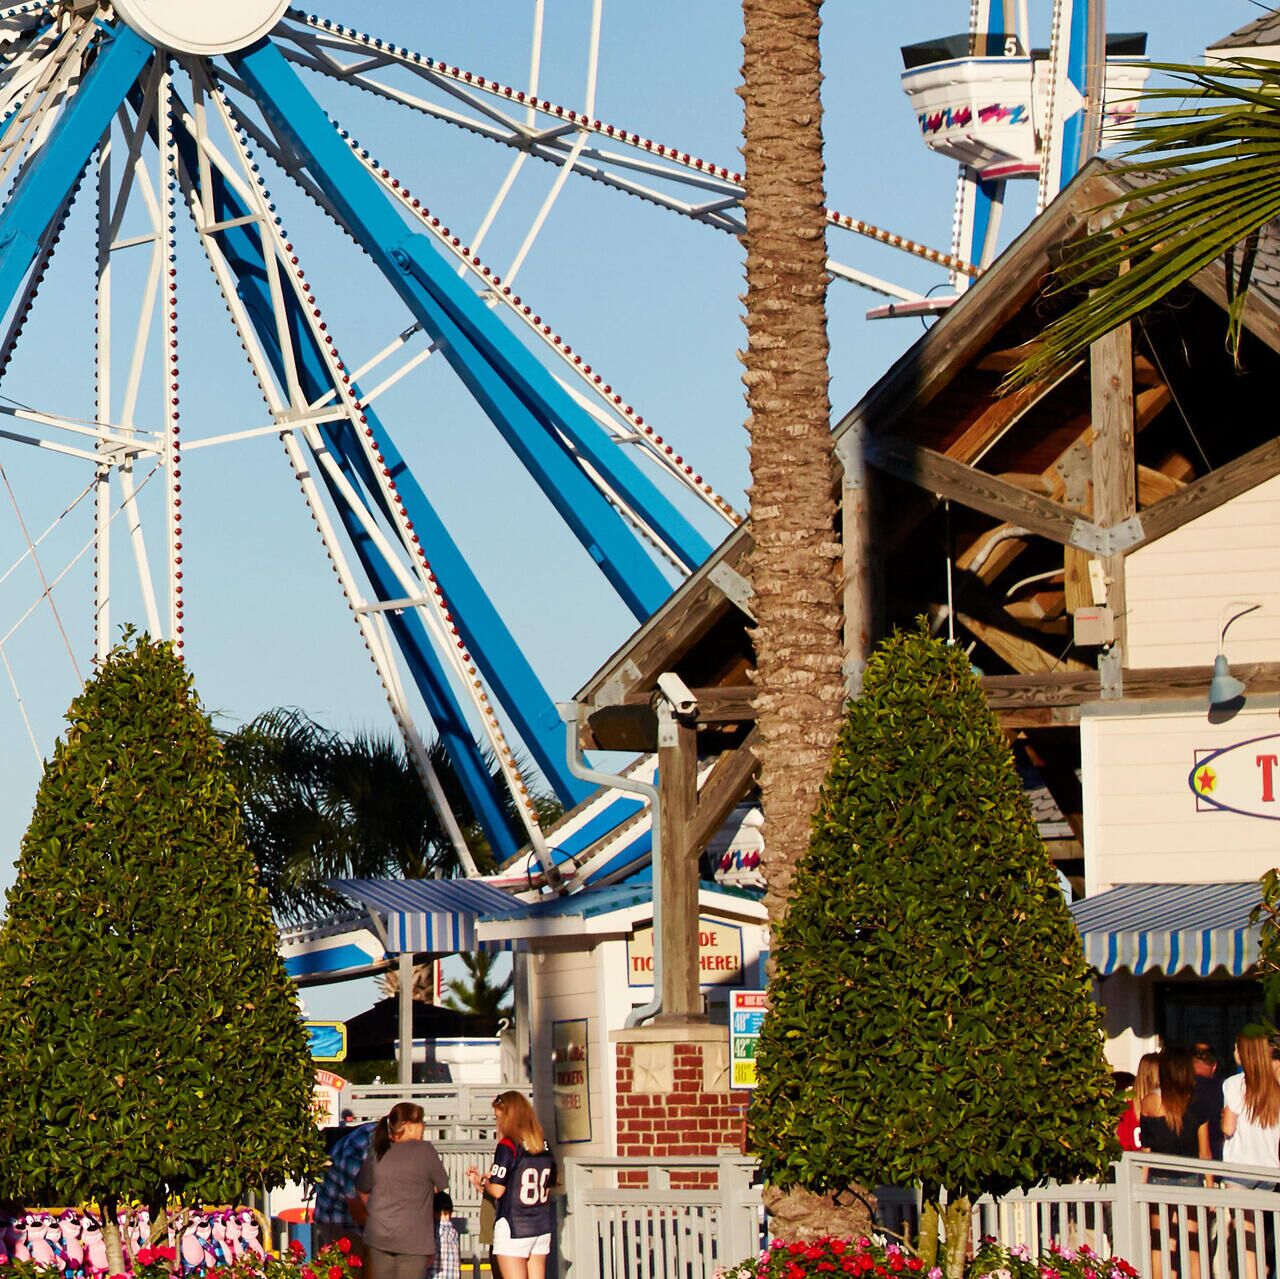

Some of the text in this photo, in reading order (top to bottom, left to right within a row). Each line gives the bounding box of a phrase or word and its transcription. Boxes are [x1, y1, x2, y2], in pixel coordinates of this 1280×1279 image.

[1004, 37, 1017, 57] 5
[491, 1164, 507, 1179] 80
[520, 1167, 551, 1206] 80
